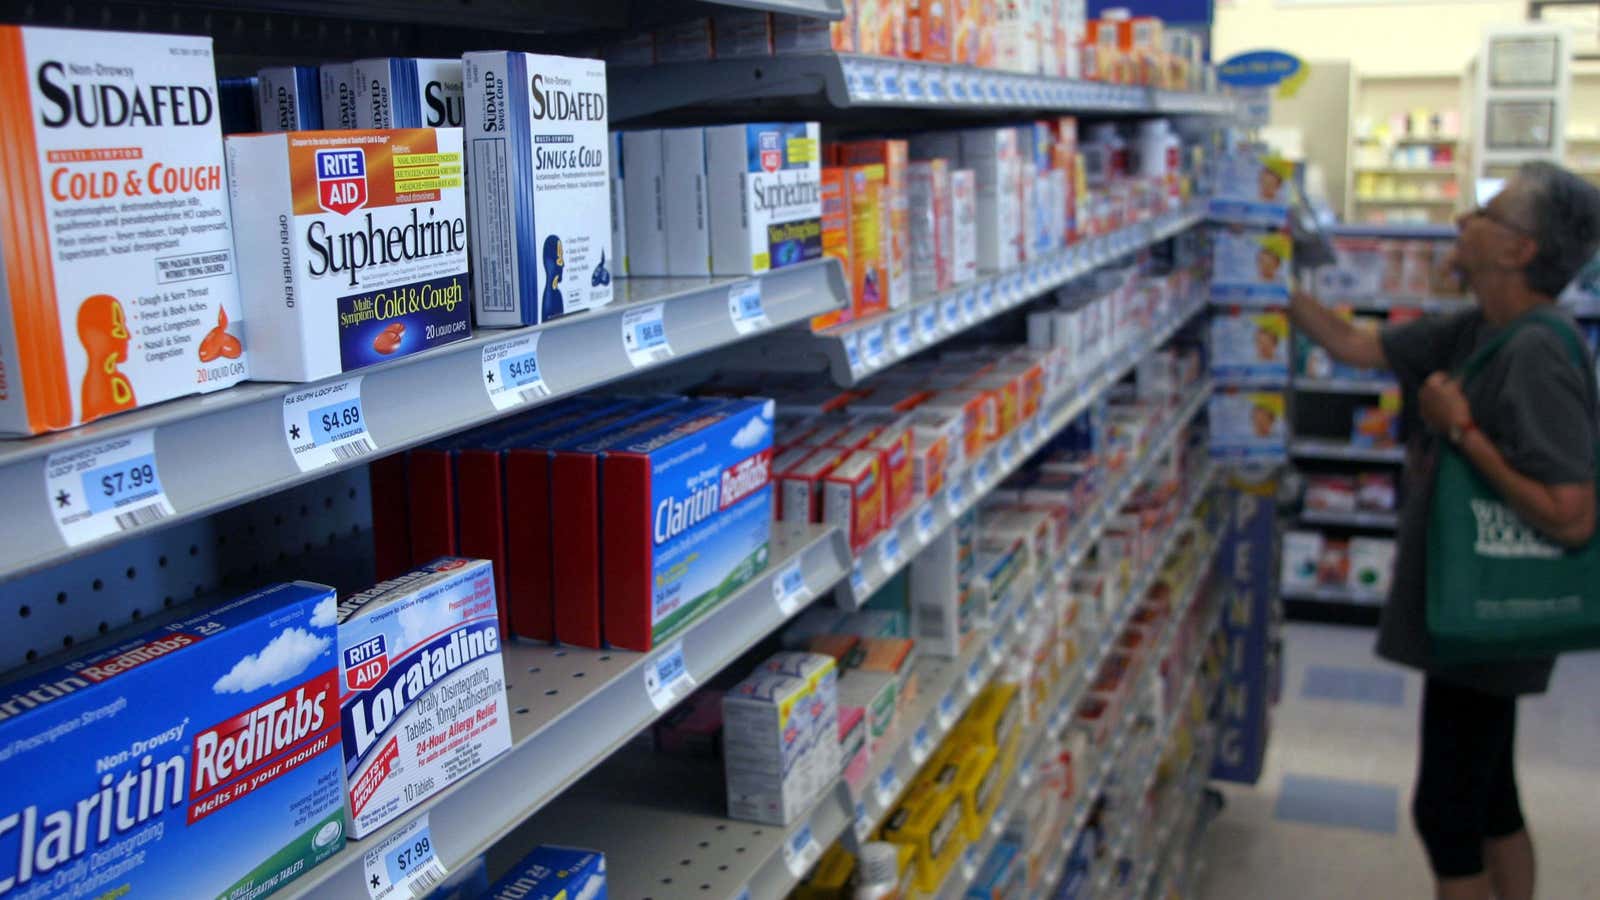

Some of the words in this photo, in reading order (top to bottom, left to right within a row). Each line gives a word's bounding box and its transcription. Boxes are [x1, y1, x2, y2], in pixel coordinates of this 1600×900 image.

[38, 60, 213, 128] SUDAFED
[484, 71, 497, 132] SUDAFED
[532, 74, 604, 121] SUDAFED
[323, 153, 359, 176] RITE
[536, 146, 568, 170] SINUS
[569, 151, 577, 168] &
[578, 146, 602, 168] COLD
[51, 167, 118, 202] COLD
[124, 170, 142, 197] &
[148, 162, 221, 195] COUGH
[329, 182, 359, 206] AID
[279, 214, 289, 244] OPEN
[307, 208, 465, 286] Suphedrine
[282, 247, 293, 284] OTHER
[285, 286, 295, 308] END
[374, 288, 407, 320] Cold
[408, 288, 420, 313] &
[421, 278, 462, 312] Cough
[341, 309, 374, 328] Symptom
[426, 325, 435, 340] 20
[435, 324, 452, 336] LIQUID
[452, 320, 467, 333] CAPS
[197, 369, 208, 383] 20
[509, 358, 536, 378] $4.69
[322, 406, 360, 432] $4.69
[101, 464, 154, 496] $7.99
[655, 482, 718, 544] Claritin
[721, 451, 770, 508] RediTabs
[80, 634, 193, 682] RediTabs
[350, 638, 381, 666] RITE
[352, 626, 497, 757] Loratadine
[355, 661, 382, 687] AID
[417, 692, 439, 716] Orally
[441, 667, 489, 703] Disintegrating
[15, 718, 81, 754] Prescription
[81, 696, 128, 727] Strength
[405, 717, 435, 742] Tablets,
[436, 679, 502, 725] 10mg/Antihistamine
[416, 731, 447, 757] 24-Hour
[448, 716, 475, 739] Allergy
[476, 699, 498, 720] Relief
[195, 688, 326, 792] RediTabs
[193, 790, 231, 818] Melts
[234, 782, 248, 796] in
[250, 764, 282, 792] your
[285, 735, 329, 769] mouth!
[355, 767, 385, 812] MOUTH
[404, 783, 413, 803] 10
[91, 821, 164, 871] Disintegrating
[397, 837, 430, 870] $7.99
[280, 859, 304, 880] TABLETS
